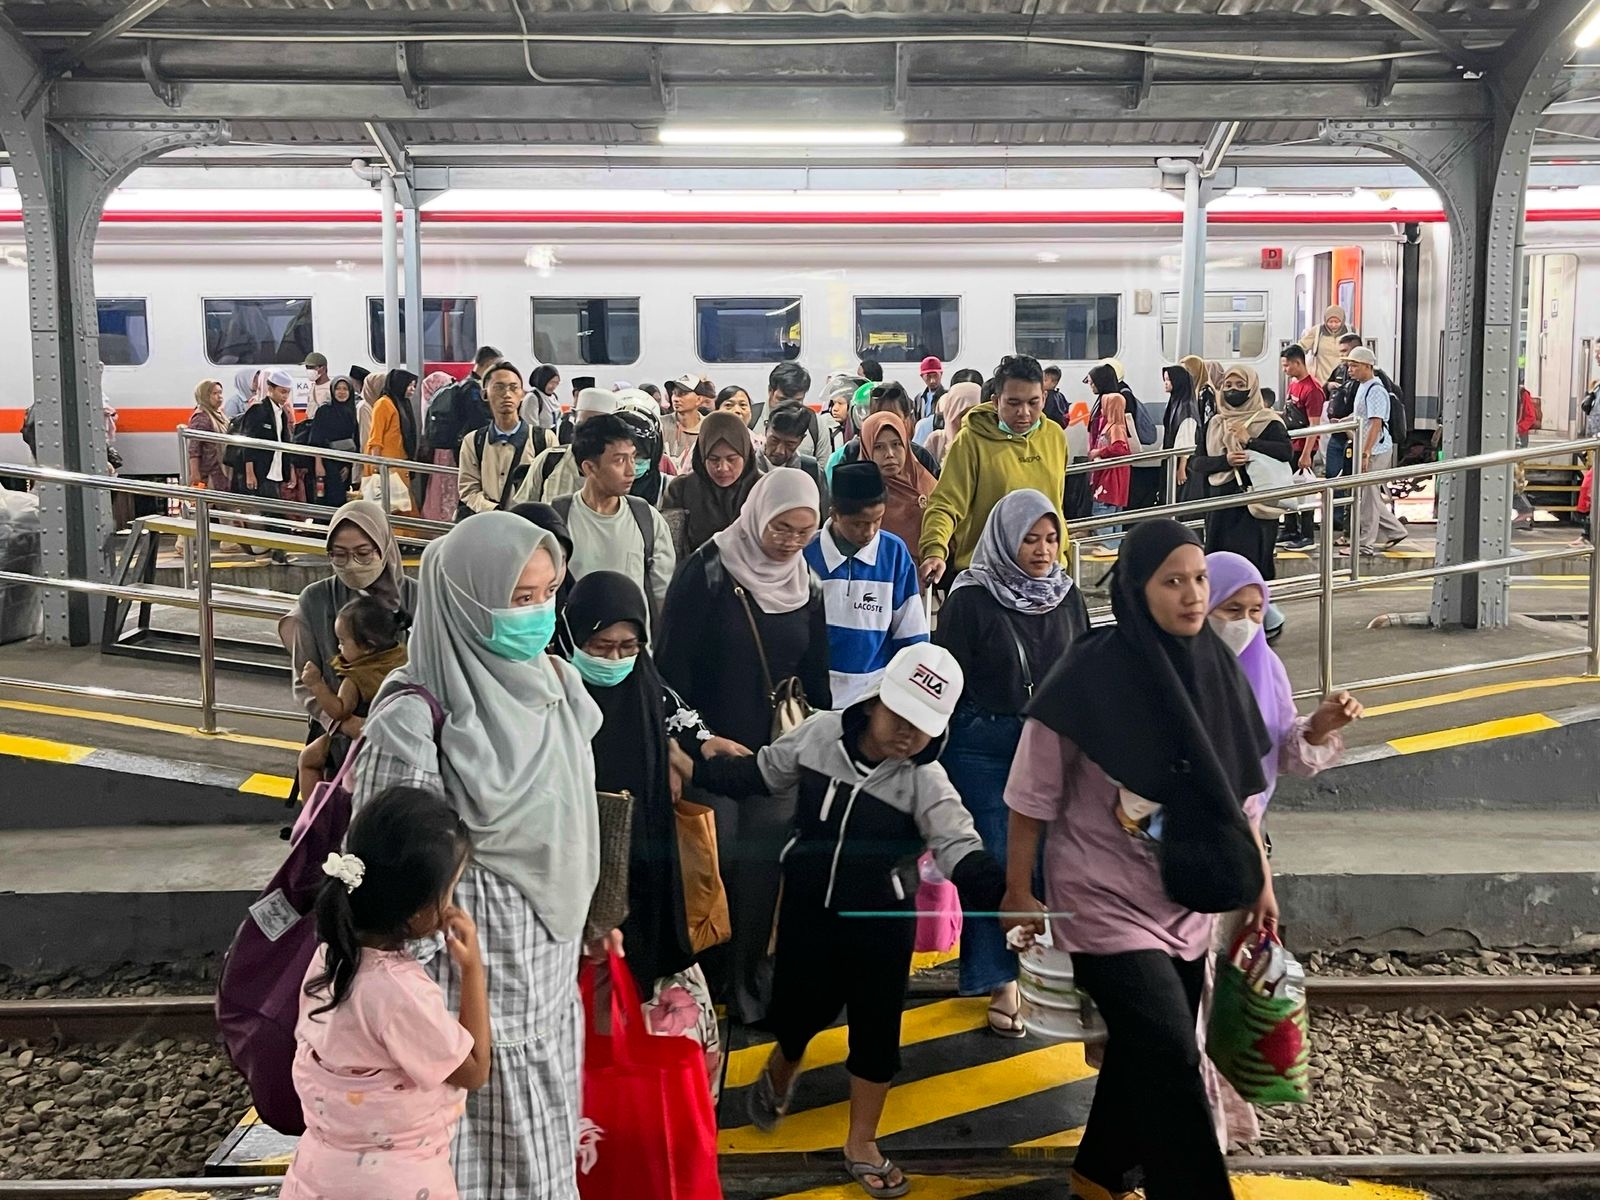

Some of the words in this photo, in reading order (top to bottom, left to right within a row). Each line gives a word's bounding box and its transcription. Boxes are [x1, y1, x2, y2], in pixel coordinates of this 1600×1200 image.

[1268, 249, 1278, 259] D
[853, 601, 883, 613] LACOSTE
[913, 667, 943, 695] FILA
